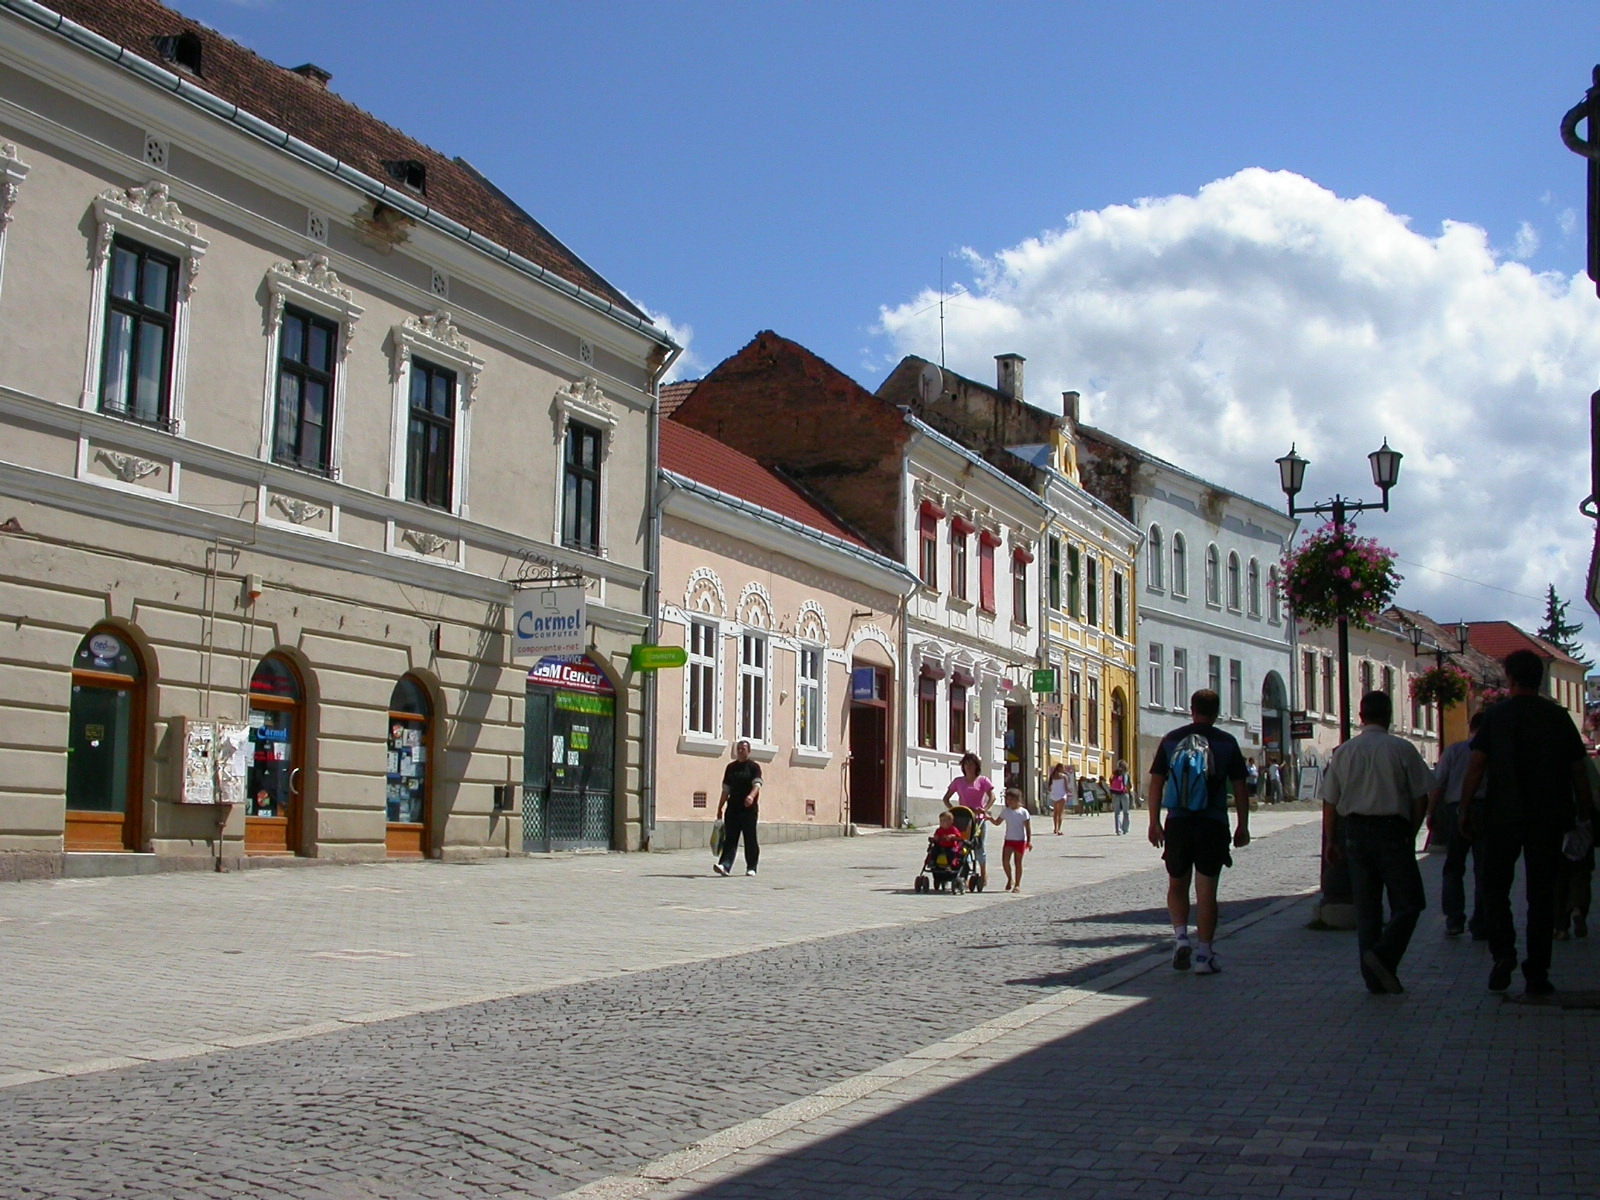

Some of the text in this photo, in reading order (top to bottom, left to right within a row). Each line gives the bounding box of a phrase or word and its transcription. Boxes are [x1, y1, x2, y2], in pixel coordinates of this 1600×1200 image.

[517, 608, 580, 639] Carmel
[534, 631, 578, 639] COMPUTER
[517, 643, 579, 654] componente.net
[563, 666, 603, 685] Center
[257, 726, 287, 740] Carmel
